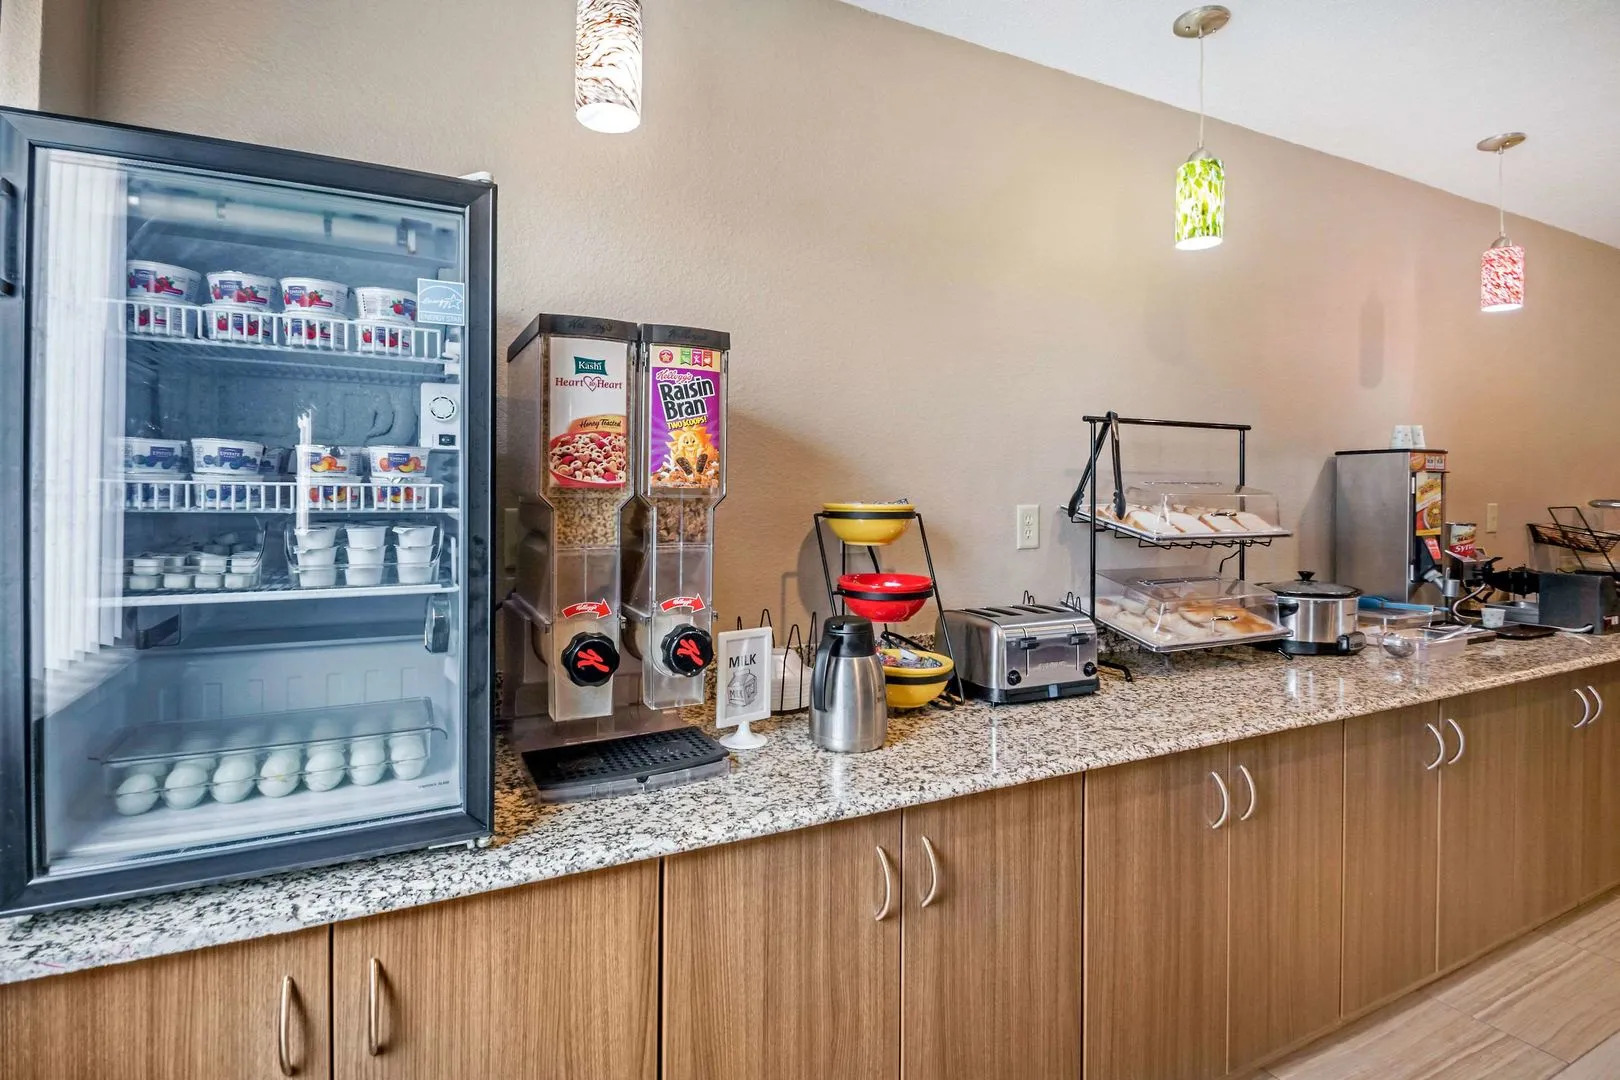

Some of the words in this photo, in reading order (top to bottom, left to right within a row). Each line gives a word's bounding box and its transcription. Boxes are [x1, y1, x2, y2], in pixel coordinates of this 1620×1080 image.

[578, 361, 602, 370] Kashi
[656, 369, 693, 383] Kellogg's
[555, 377, 583, 387] Heart
[597, 379, 623, 389] Heart
[658, 377, 715, 401] Raisin
[663, 398, 707, 421] Bran
[579, 419, 600, 429] Honey
[667, 420, 682, 430] TWO
[729, 653, 756, 668] MILK
